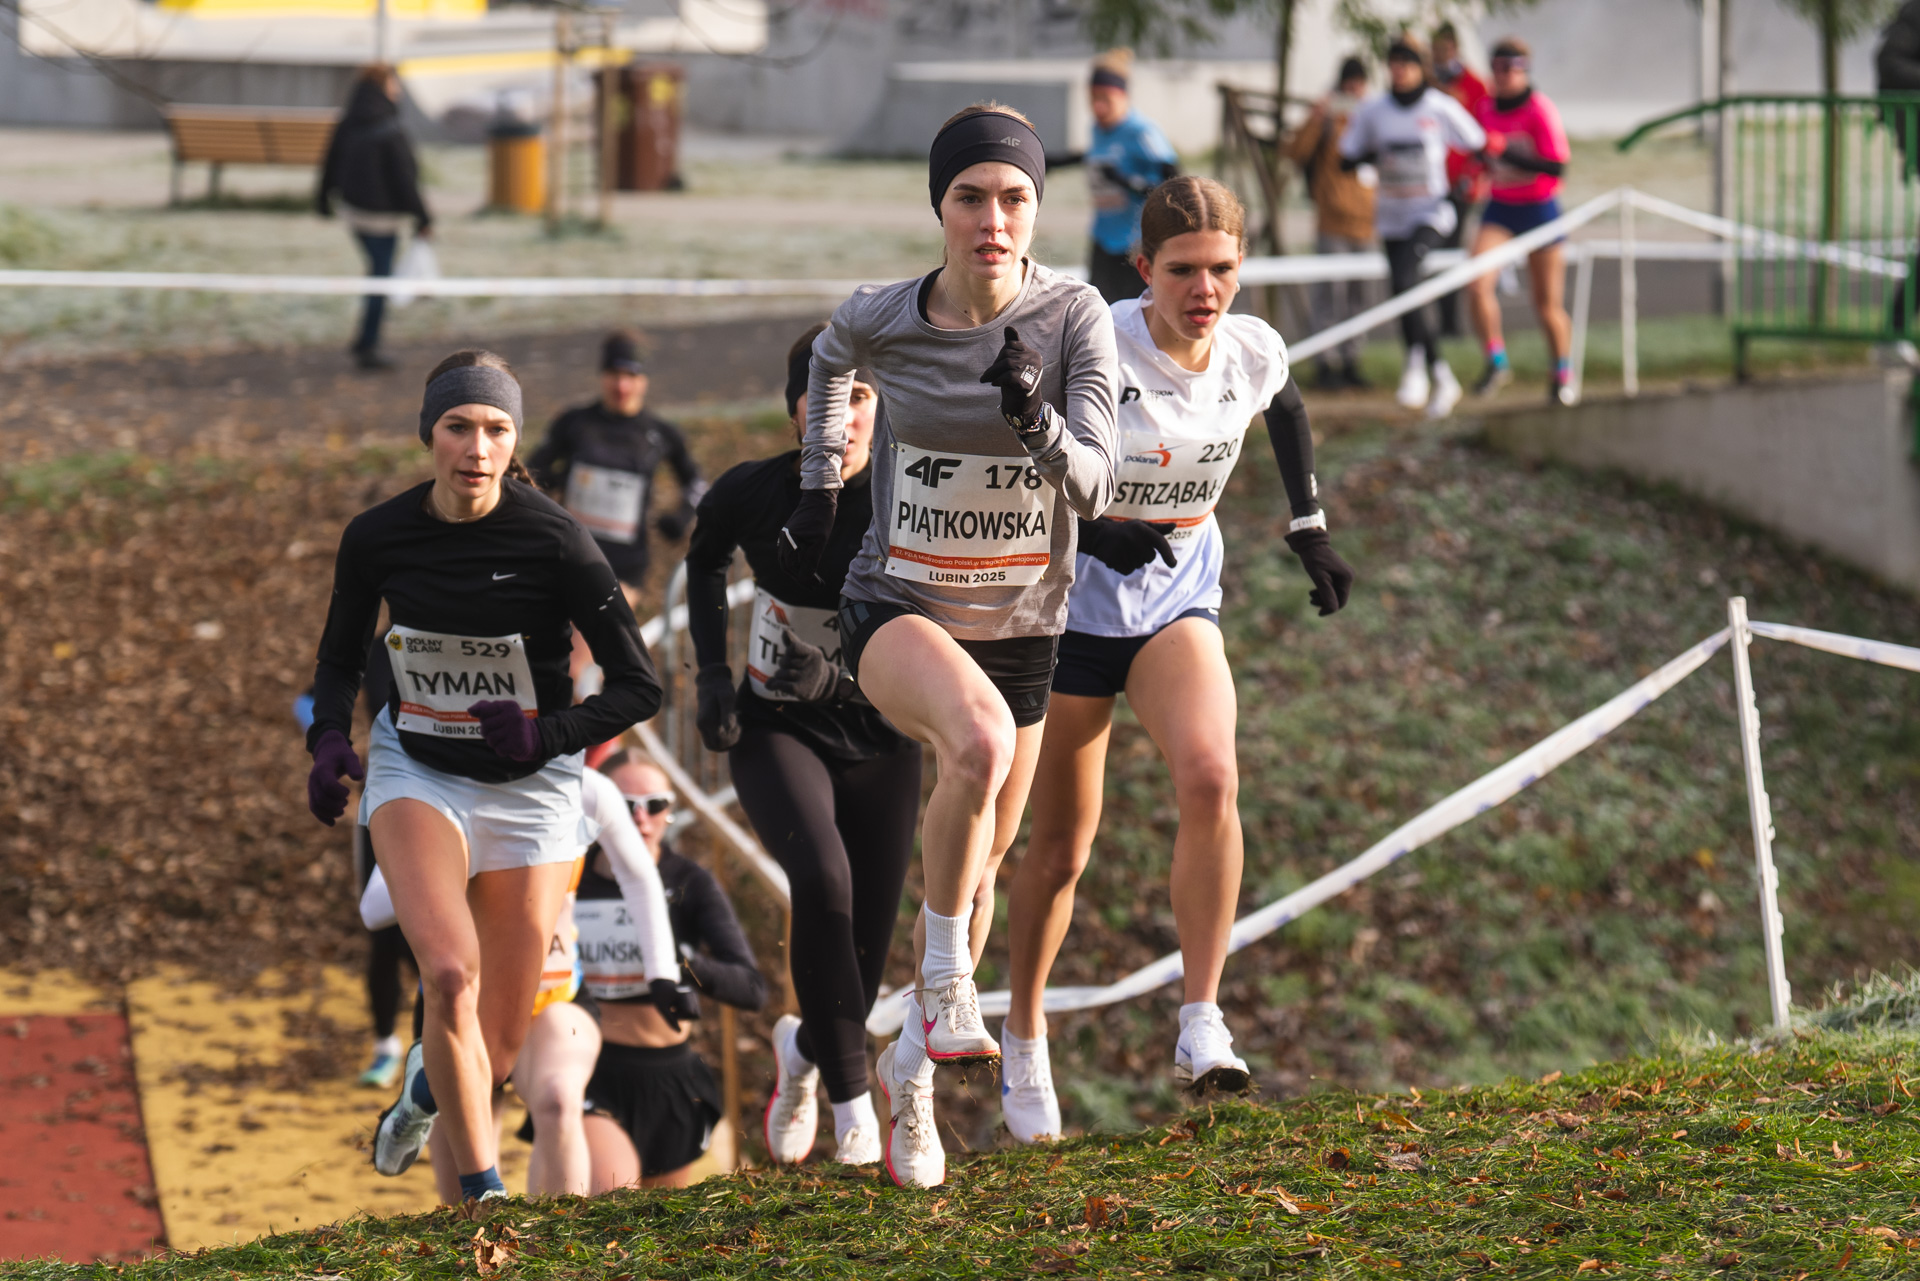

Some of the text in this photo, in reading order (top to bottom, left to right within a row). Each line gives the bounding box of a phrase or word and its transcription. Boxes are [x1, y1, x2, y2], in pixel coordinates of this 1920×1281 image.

[1000, 136, 1021, 147] 4F
[1197, 438, 1238, 463] 220
[904, 455, 963, 489] 4F
[985, 464, 1043, 490] 178
[897, 500, 1047, 543] PIĄTKOWSKA
[1167, 530, 1193, 540] 2025
[929, 571, 1006, 584] LUBIN 2025
[405, 637, 443, 649] DOLNY
[461, 640, 510, 658] 529
[405, 670, 516, 696] TYMAN
[433, 723, 466, 735] LUBIN
